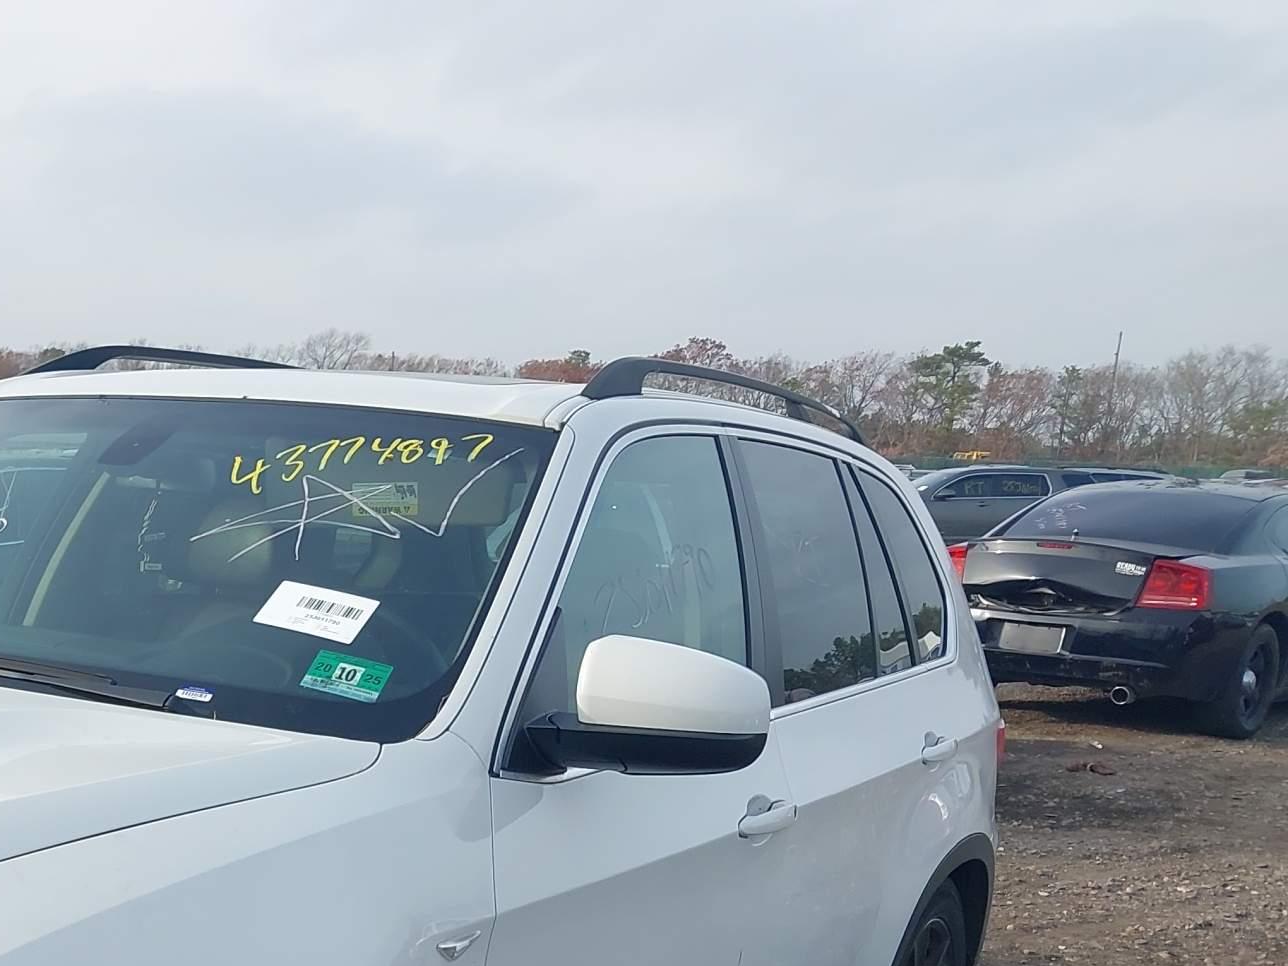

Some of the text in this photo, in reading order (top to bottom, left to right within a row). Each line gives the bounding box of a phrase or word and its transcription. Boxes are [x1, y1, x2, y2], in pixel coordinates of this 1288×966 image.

[230, 433, 494, 495] 43774897
[315, 662, 332, 673] 20
[335, 666, 357, 682] 10
[364, 674, 383, 685] 25
